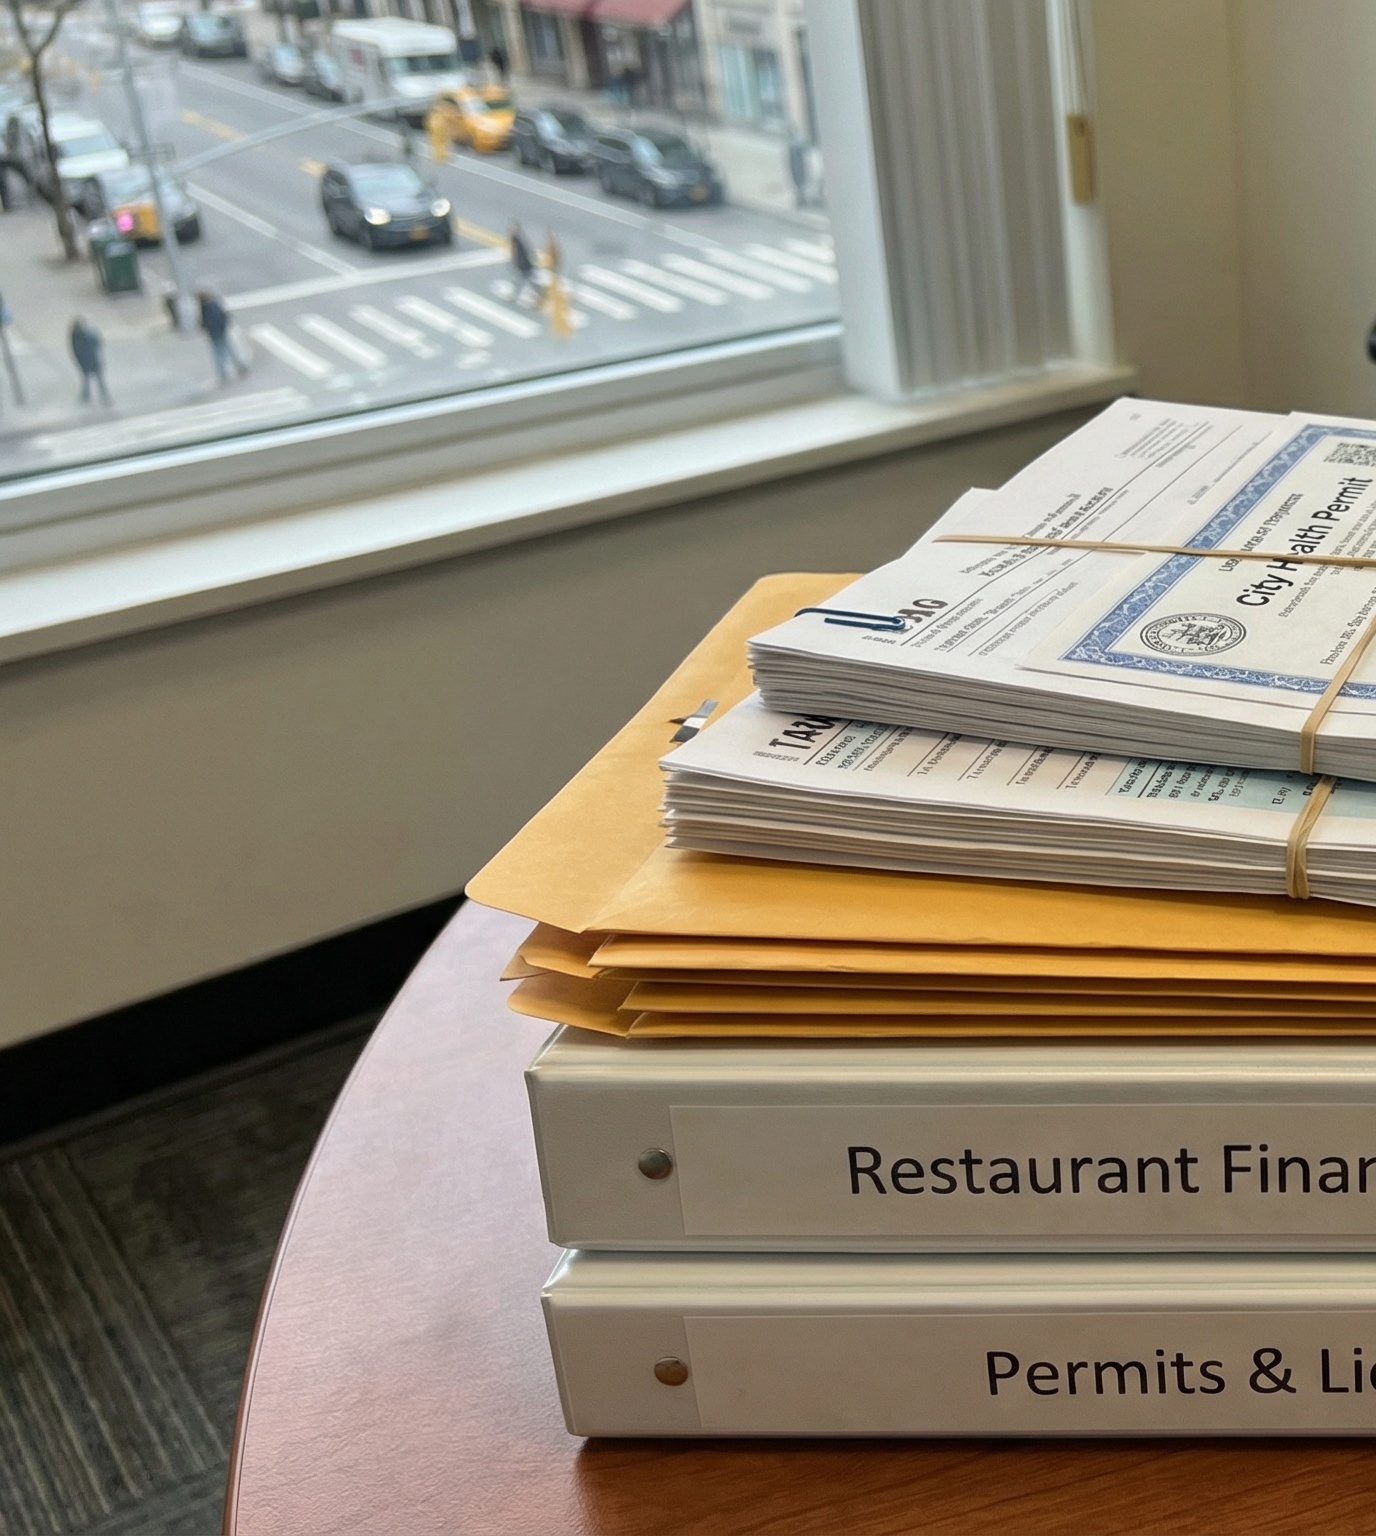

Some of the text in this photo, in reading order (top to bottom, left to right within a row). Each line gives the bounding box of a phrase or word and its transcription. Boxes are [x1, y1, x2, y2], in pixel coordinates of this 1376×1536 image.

[1236, 573, 1294, 607] City
[1266, 524, 1333, 572] Halth
[1311, 477, 1374, 521] Permit
[848, 1144, 1200, 1197] Restaurant
[985, 1348, 1225, 1396] Permits
[1248, 1347, 1298, 1395] &
